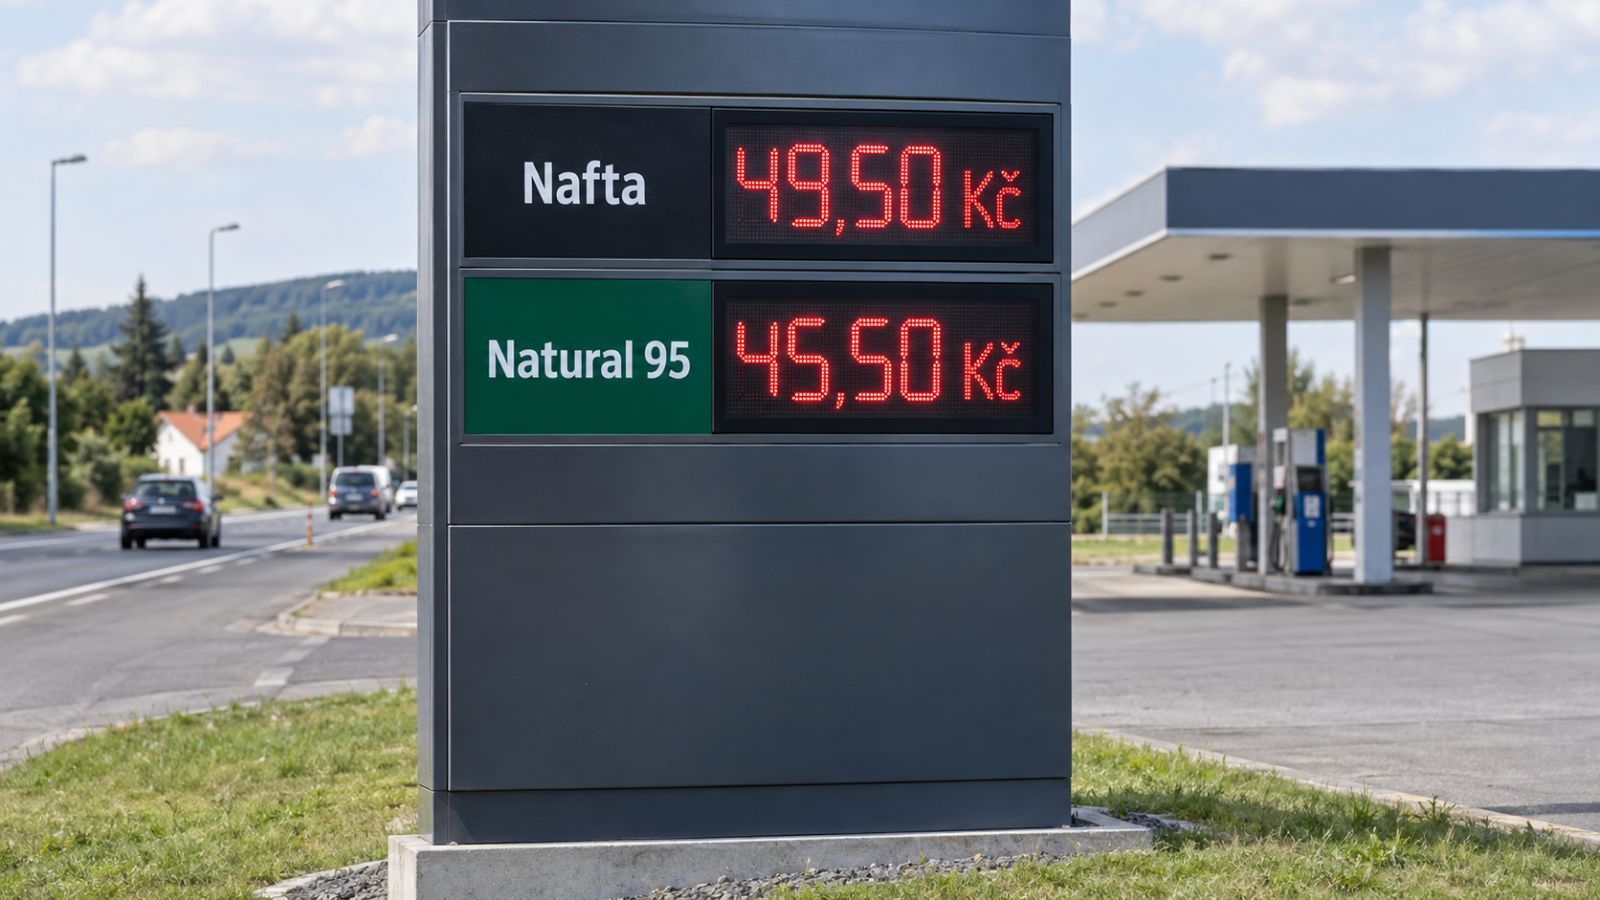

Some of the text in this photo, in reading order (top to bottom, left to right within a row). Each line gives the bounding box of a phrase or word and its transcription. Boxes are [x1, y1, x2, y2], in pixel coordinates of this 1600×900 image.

[524, 159, 646, 206] Nafta
[736, 143, 1021, 237] 49,50 Kč
[488, 339, 691, 379] Natural 95
[736, 316, 1021, 410] 45,50 Kč
